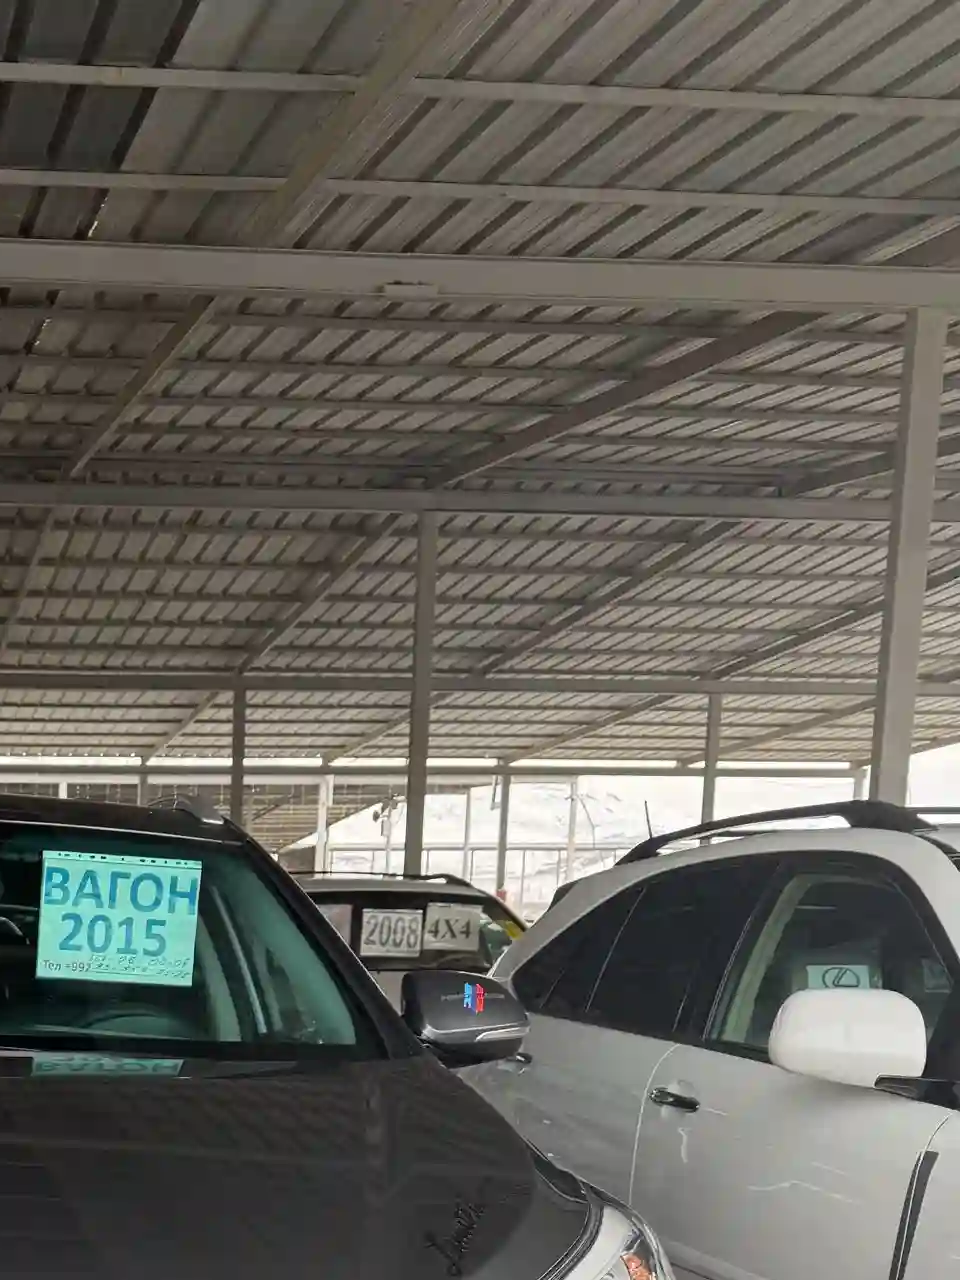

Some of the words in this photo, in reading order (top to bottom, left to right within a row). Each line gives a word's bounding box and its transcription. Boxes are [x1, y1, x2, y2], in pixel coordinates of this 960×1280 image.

[44, 866, 199, 915] ВАГОН
[58, 912, 167, 957] 2015
[363, 914, 420, 948] 2008
